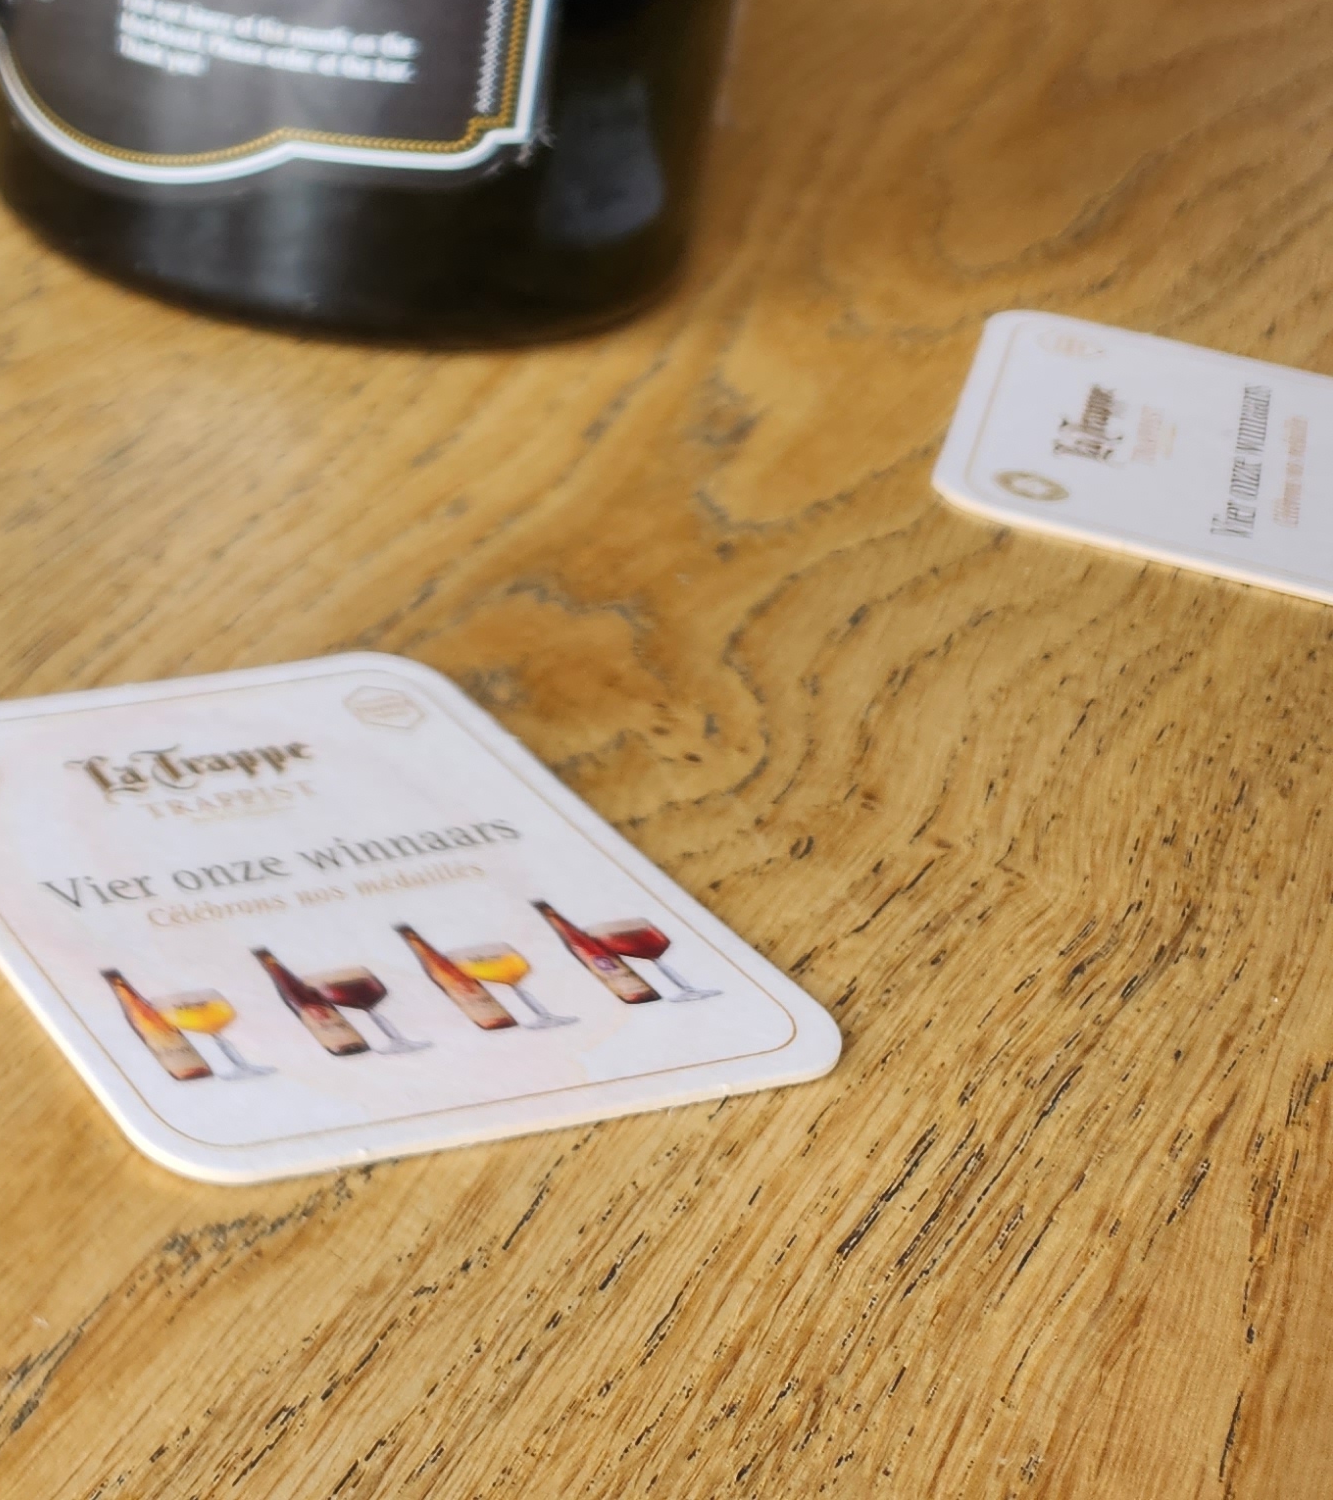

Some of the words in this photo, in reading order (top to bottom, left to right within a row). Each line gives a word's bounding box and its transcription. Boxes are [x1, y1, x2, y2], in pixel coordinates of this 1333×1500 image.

[63, 753, 149, 805] La
[132, 740, 314, 790] Trappe
[136, 779, 319, 821] TRAPPIST
[40, 872, 159, 911] Vier
[170, 856, 290, 892] onze
[296, 815, 524, 874] winnaars
[146, 890, 287, 930] Célébrons
